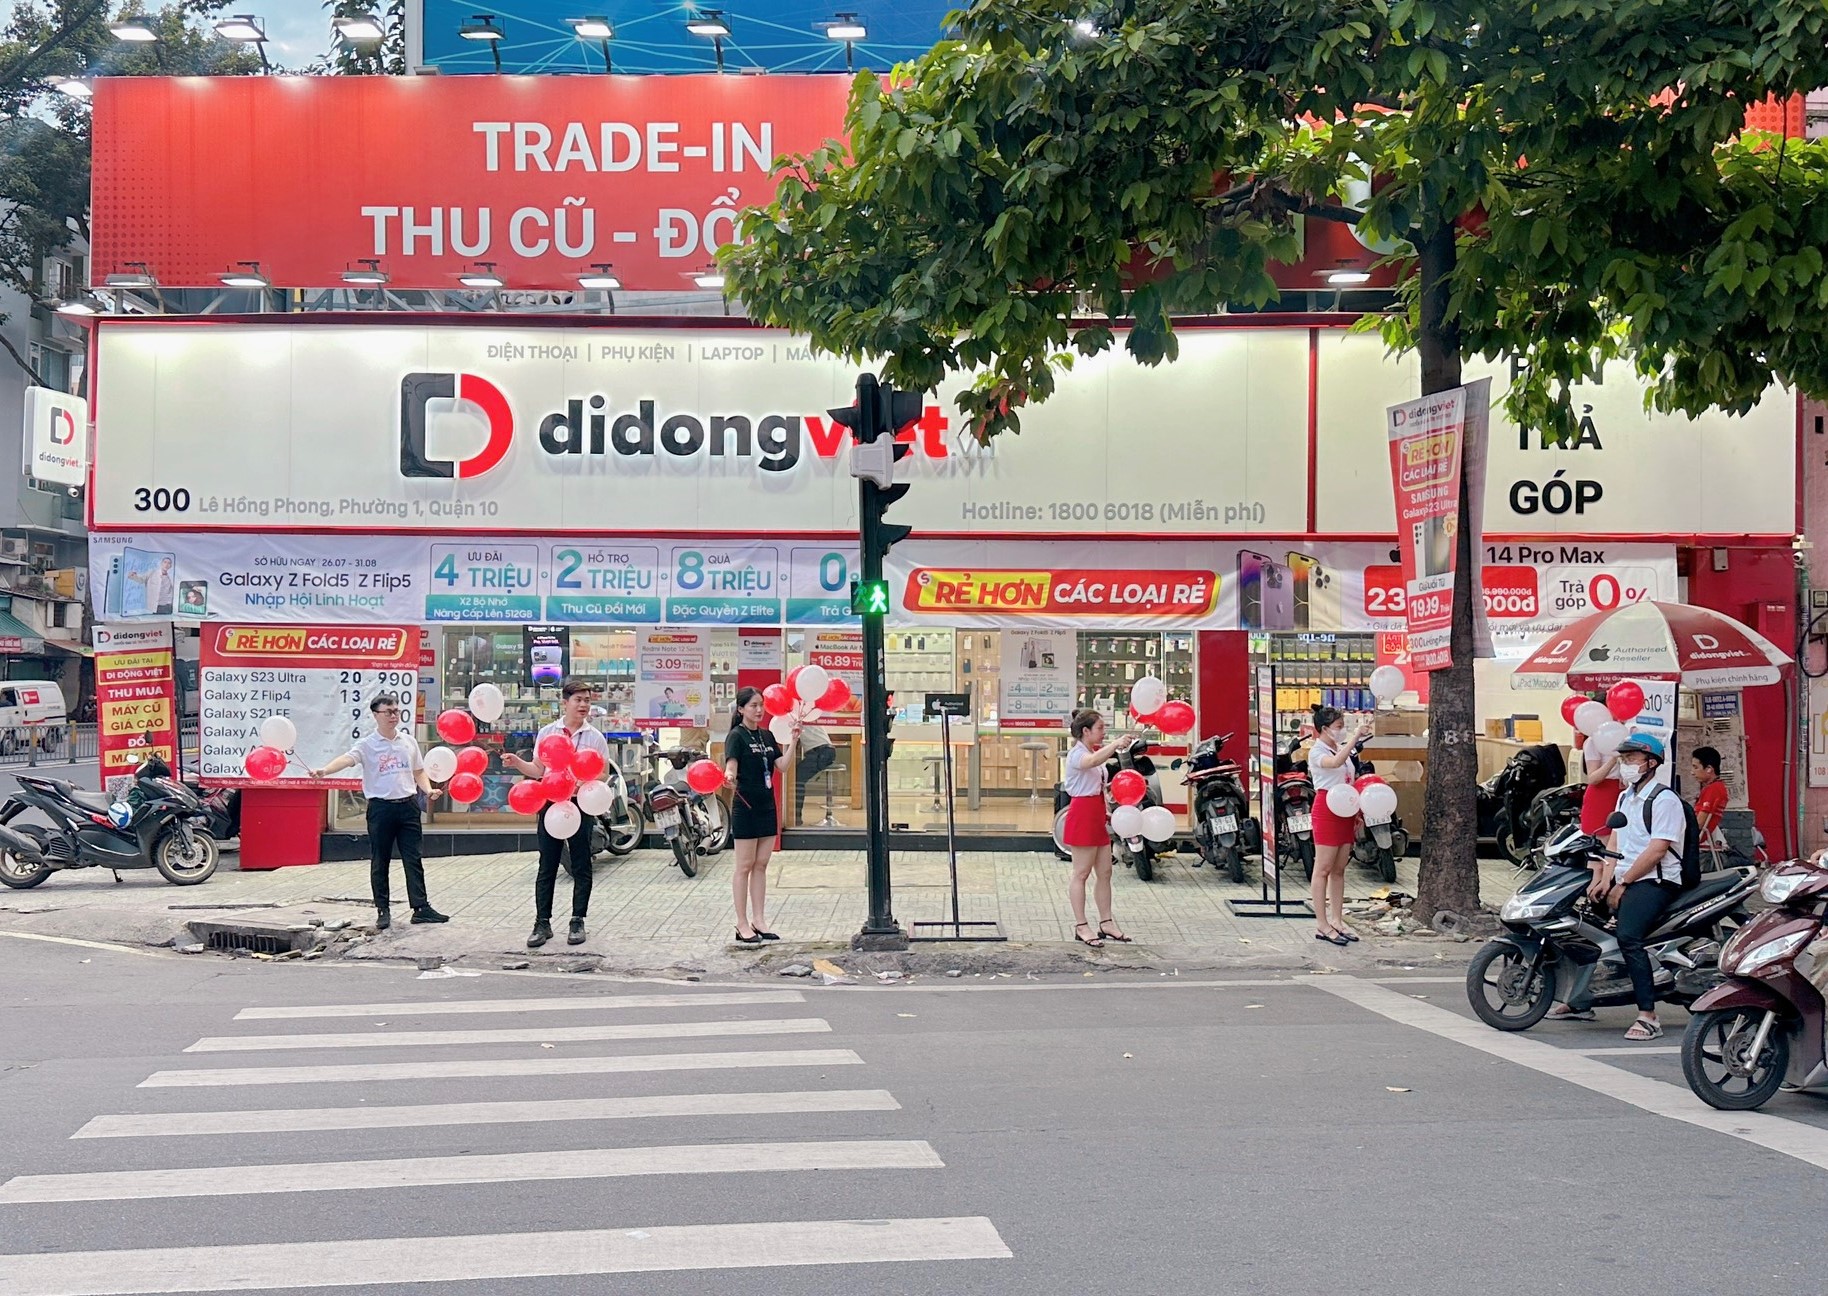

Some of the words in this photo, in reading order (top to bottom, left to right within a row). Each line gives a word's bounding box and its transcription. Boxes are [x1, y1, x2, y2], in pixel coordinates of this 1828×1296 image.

[473, 122, 772, 172] TRADE-IN
[361, 206, 492, 257] THU
[509, 196, 596, 258] CŨ
[653, 187, 745, 258] ĐỔ
[487, 345, 523, 363] ĐIỆN
[528, 345, 578, 363] THOẠI
[601, 346, 633, 363] PHỤ
[638, 345, 675, 363] KIỆN
[701, 346, 764, 361] LAPTOP
[786, 343, 813, 361] MÁ
[39, 452, 79, 467] didongviet
[1509, 470, 1604, 515] GÓP
[134, 488, 191, 512] 300
[199, 497, 218, 513] Lê
[223, 496, 269, 517] Hồng
[274, 499, 334, 517] Phong,
[339, 498, 408, 518] Phường
[412, 500, 423, 518] 1,
[429, 500, 474, 519] Quận
[479, 501, 498, 516] 10
[1440, 499, 1458, 511] Ultra
[962, 501, 1043, 520] Hotline:
[1049, 503, 1098, 520] 1800
[1104, 503, 1154, 521] 6018
[1161, 499, 1220, 523] (Miễn
[1224, 502, 1266, 524] phí)
[93, 536, 133, 544] SAMSUNG
[254, 555, 268, 567] SỞ
[270, 554, 288, 567] HỮU
[290, 557, 316, 567] NGAY
[321, 557, 345, 567] 26.07
[355, 557, 377, 567] 31.08
[468, 552, 484, 562] ƯU
[485, 550, 503, 562] ĐÃI
[588, 549, 605, 563] HỖ
[607, 551, 630, 564] TRỢ
[708, 552, 731, 565] QUÀ
[1487, 547, 1512, 563] 14
[1519, 547, 1554, 563] Pro
[1560, 547, 1605, 564] Max
[434, 554, 459, 587] 4
[556, 549, 583, 588] 2
[676, 551, 704, 590] 8
[220, 572, 284, 592] Galaxy
[289, 574, 299, 588] Z
[302, 573, 349, 588] Fold5
[358, 575, 369, 589] Z
[373, 573, 411, 592] Flip5
[468, 566, 532, 594] TRIỆU
[588, 566, 651, 596] TRIỆU
[707, 567, 771, 597] TRIỆU
[1560, 579, 1584, 593] Trả
[935, 574, 973, 605] RẺ
[978, 581, 1046, 606] HƠN
[1054, 578, 1106, 603] CÁC
[1110, 583, 1168, 609] LOẠI
[1173, 578, 1207, 604] RẺ
[245, 592, 286, 610] Nhập
[289, 593, 312, 608] Hội
[315, 593, 344, 607] Linh
[348, 594, 384, 609] Hoạt
[460, 598, 471, 606] X2
[473, 597, 487, 607] Bộ
[489, 596, 508, 606] Nhớ
[562, 603, 583, 614] Thu
[586, 603, 602, 614] Cũ
[605, 601, 624, 615] Đổi
[627, 602, 646, 615] Mới
[1555, 594, 1587, 610] góp
[433, 608, 459, 620] Nâng
[461, 607, 481, 620] Cấp
[484, 607, 502, 618] Lên
[504, 608, 533, 619] 512GB
[672, 604, 696, 618] Đặc
[699, 603, 738, 618] Quyền
[750, 605, 775, 617] Elite
[820, 604, 840, 616] Trả
[113, 629, 163, 640] didongviet
[236, 627, 259, 649] RẺ
[262, 632, 302, 650] HƠN
[308, 630, 339, 650] CÁC
[342, 634, 377, 653] LOẠI
[378, 629, 398, 650] RẺ
[1614, 645, 1667, 653] Authorised
[655, 658, 682, 669] 3.09
[818, 655, 850, 667] 16.89
[144, 667, 164, 678] VIỆT
[205, 671, 248, 684] Galaxy
[250, 672, 275, 682] S23
[278, 672, 306, 683] Ultra
[1696, 677, 1710, 685] Phụ
[1712, 675, 1726, 684] kiện
[1728, 673, 1747, 682] chính
[108, 688, 132, 699] THU
[136, 686, 163, 697] MUA
[204, 689, 247, 702] Galaxy
[250, 690, 258, 700] Z
[262, 690, 291, 702] Flip4
[112, 703, 139, 716] MÁY
[143, 701, 161, 714] CŨ
[204, 708, 247, 721] Galaxy
[250, 708, 272, 719] S21
[111, 718, 133, 731] GIÁ
[137, 718, 164, 729] CAO
[203, 726, 246, 739] Galaxy
[203, 745, 246, 757] Galaxy
[203, 763, 245, 776] Galaxy
